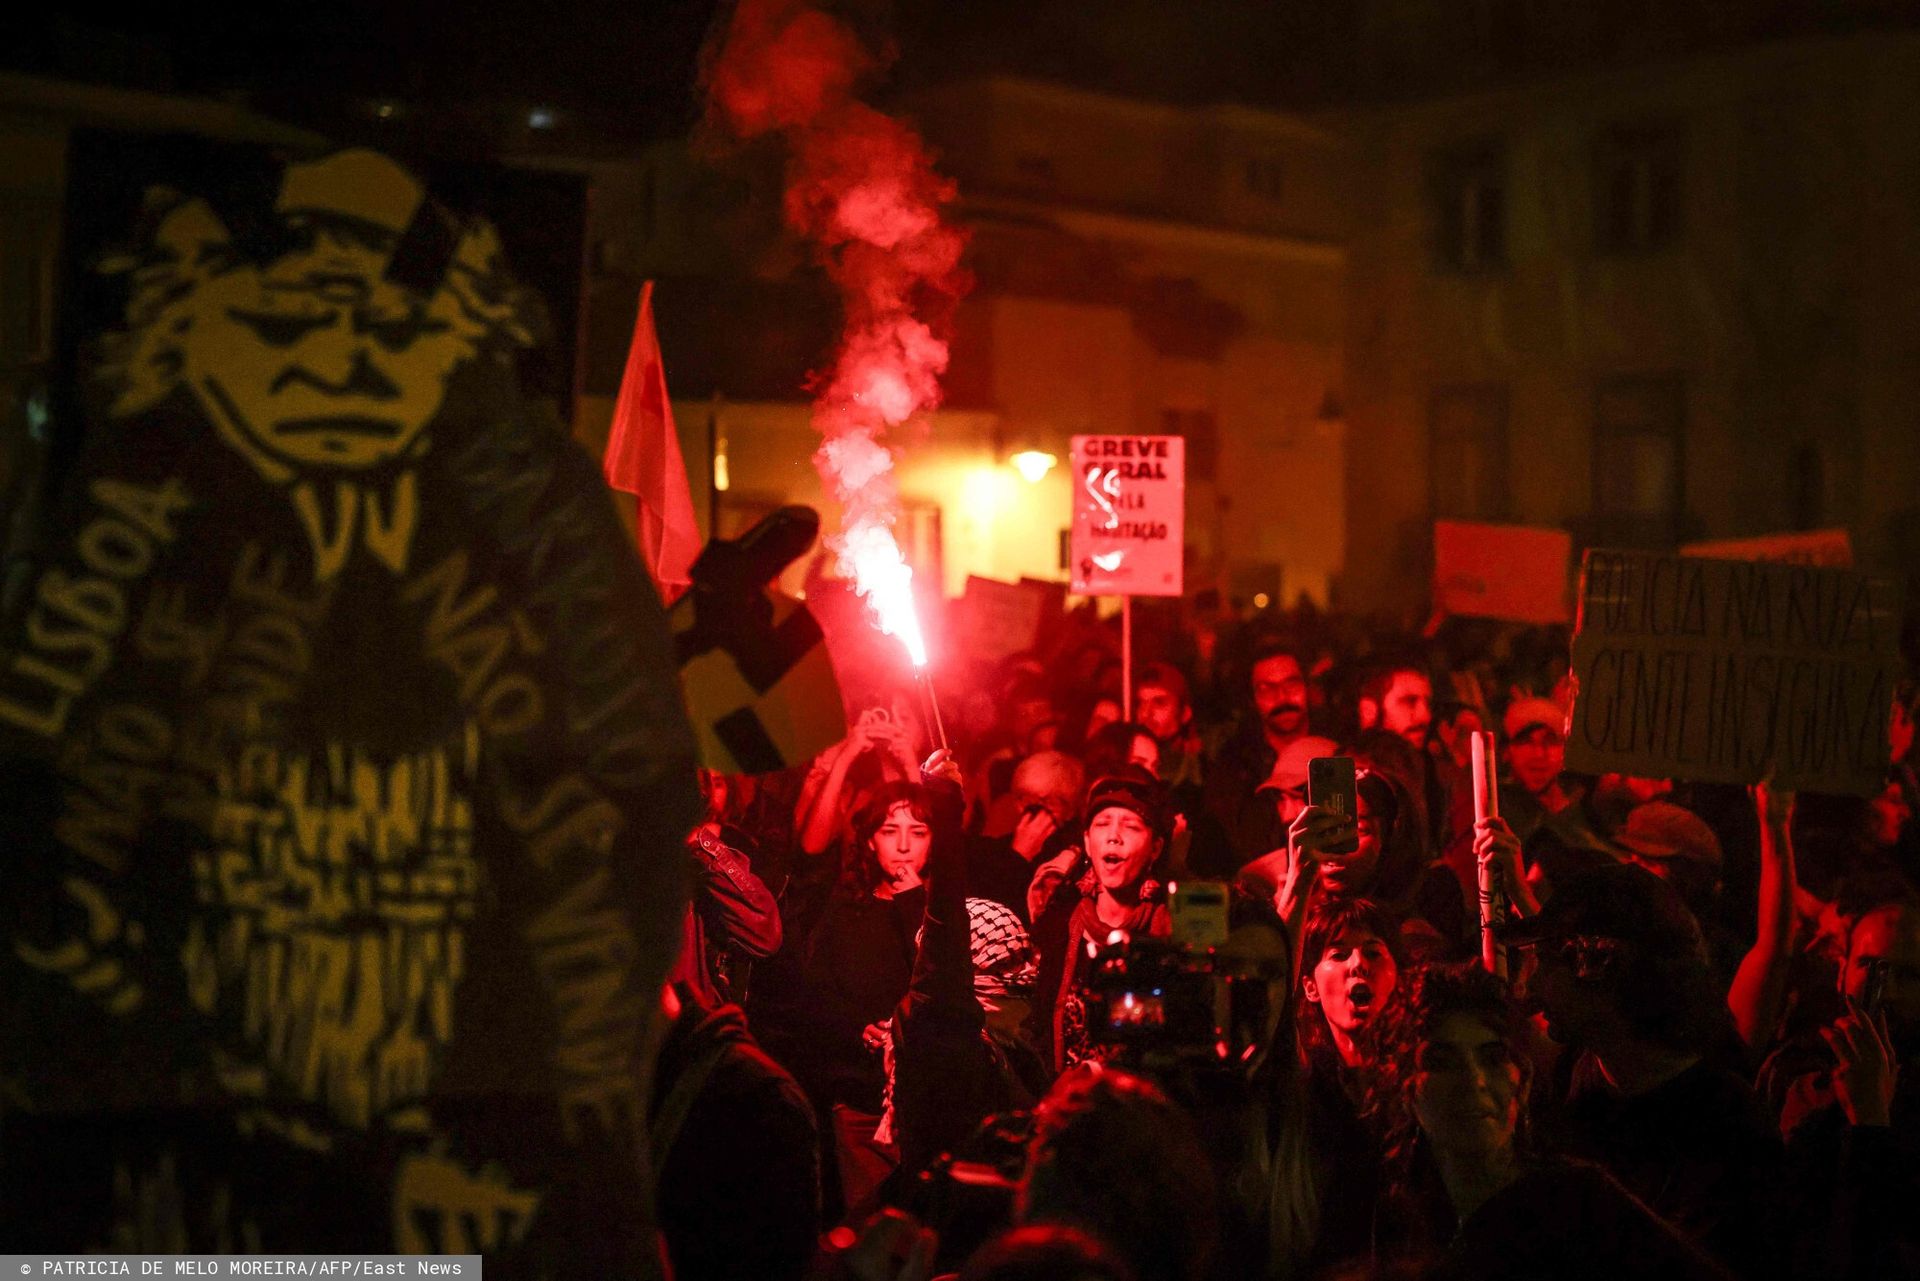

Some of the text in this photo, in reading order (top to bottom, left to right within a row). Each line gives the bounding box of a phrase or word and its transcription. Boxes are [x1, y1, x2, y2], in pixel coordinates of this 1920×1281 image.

[1083, 439, 1168, 457] GREVE
[0, 475, 195, 738] LISBOA
[401, 547, 545, 737] NÃO
[1723, 562, 1773, 647] NA
[1785, 566, 1875, 652] RUA
[1583, 647, 1887, 773] GENTE INSEGURA
[54, 701, 174, 872] NÃO
[495, 770, 624, 870] SE
